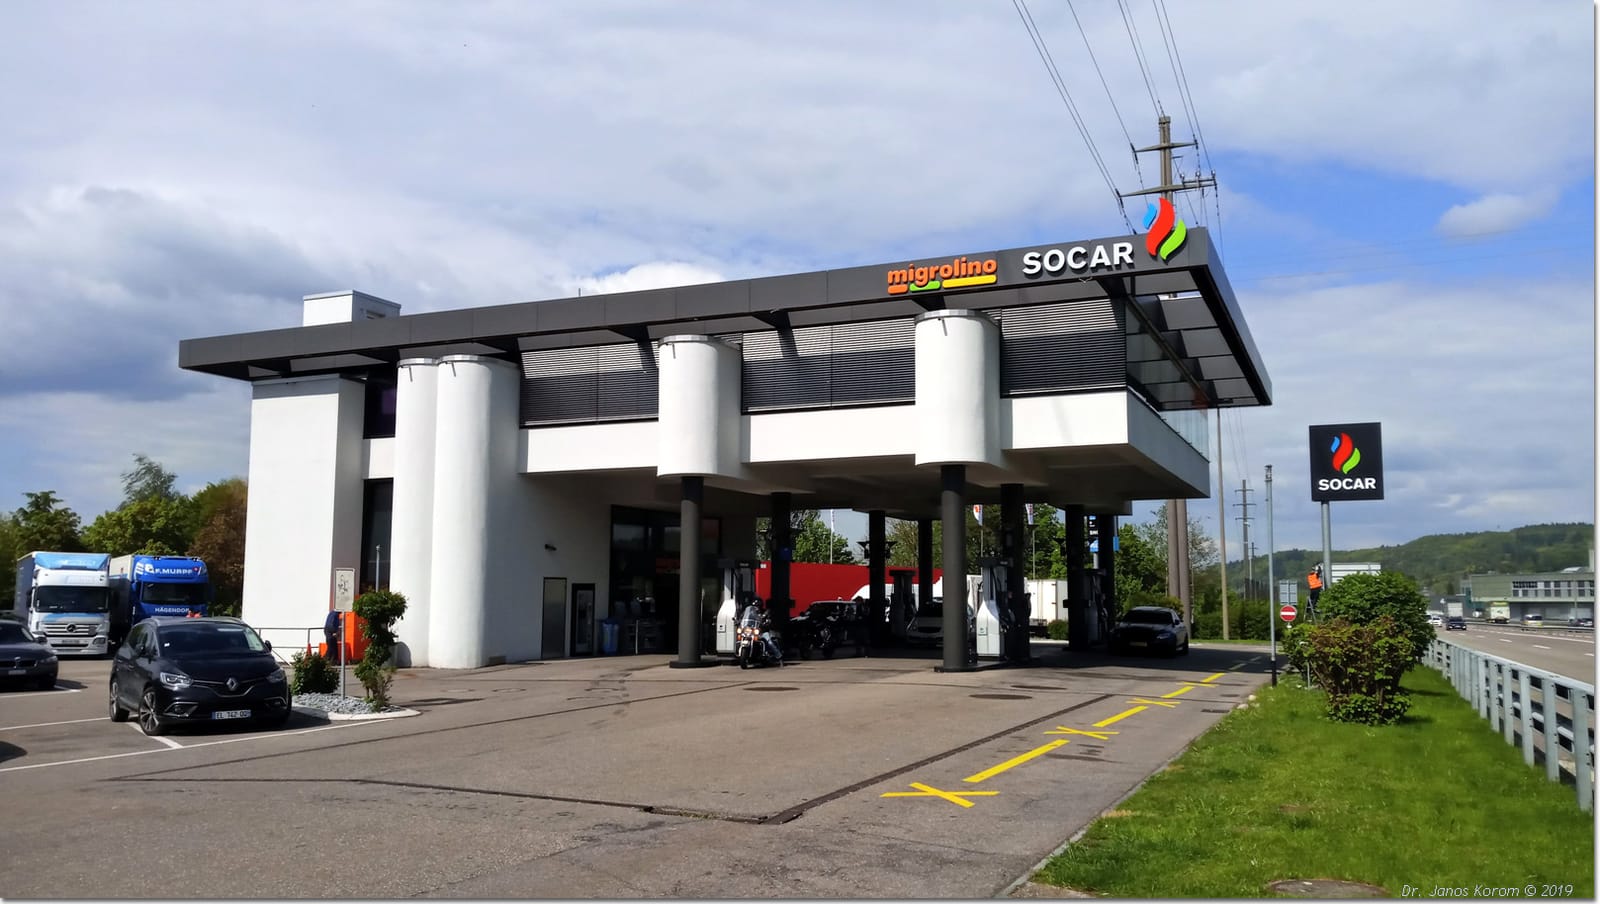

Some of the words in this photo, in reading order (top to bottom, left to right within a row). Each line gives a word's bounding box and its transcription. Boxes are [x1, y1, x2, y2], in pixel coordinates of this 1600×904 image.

[887, 257, 998, 286] migrolino
[1022, 242, 1134, 275] SOCAR
[1318, 477, 1376, 491] SOCAR
